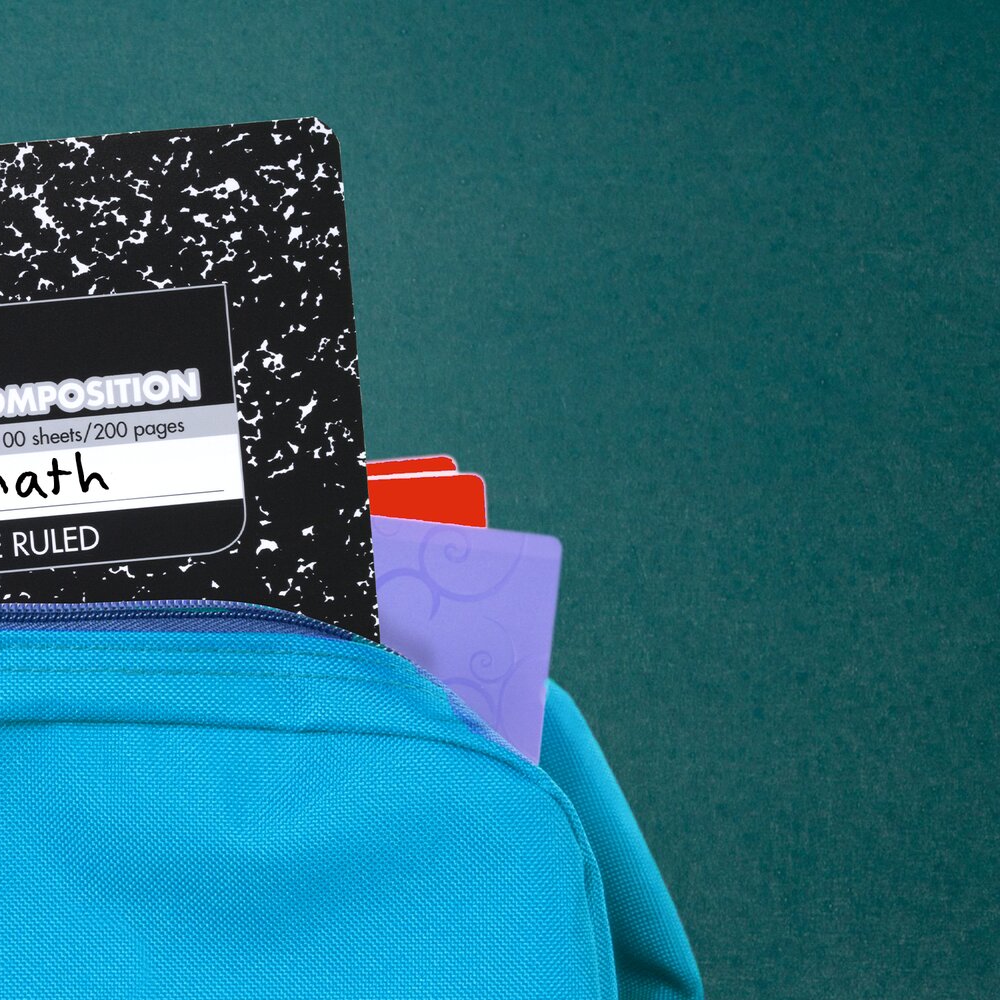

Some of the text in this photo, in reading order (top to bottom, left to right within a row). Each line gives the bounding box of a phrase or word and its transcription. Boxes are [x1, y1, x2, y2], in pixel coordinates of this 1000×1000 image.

[32, 421, 128, 446] sheets/200
[133, 420, 185, 442] pages
[12, 525, 100, 556] RULED
